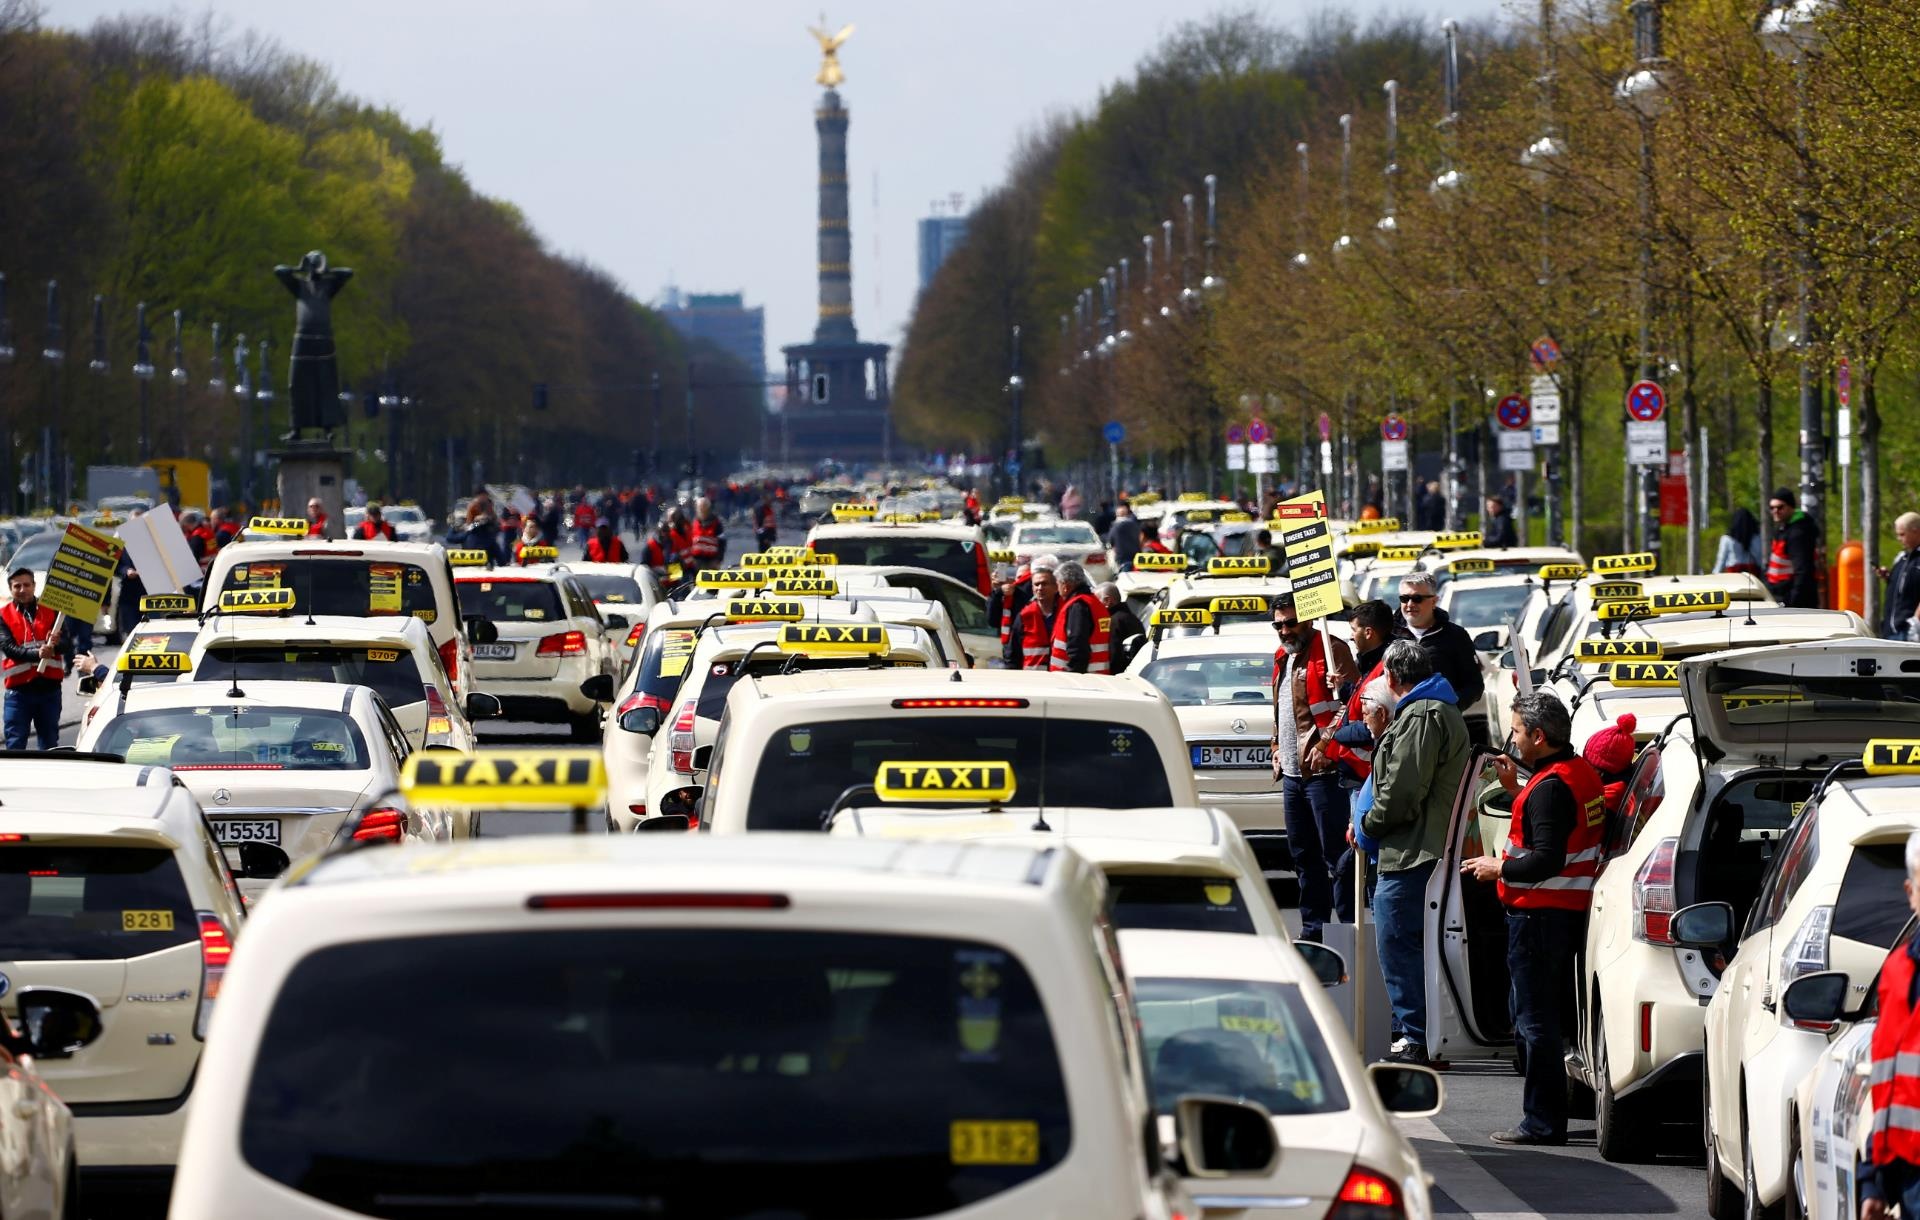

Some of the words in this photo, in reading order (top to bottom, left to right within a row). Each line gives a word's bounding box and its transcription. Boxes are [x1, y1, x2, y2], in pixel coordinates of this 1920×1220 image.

[260, 518, 298, 528] TAXI
[1285, 532, 1304, 542] UNSERE
[1303, 528, 1317, 537] TAXIS
[748, 556, 787, 565] TAXI
[1144, 556, 1178, 564] TAXI
[1219, 559, 1260, 568] TAXI
[1290, 556, 1308, 566] UNSERE
[1308, 552, 1321, 561] JOBS
[1604, 555, 1645, 567] TAXI
[1458, 562, 1487, 570] TAXI
[709, 571, 755, 581] TAXI
[775, 569, 815, 578] TAXI
[1551, 567, 1580, 577] TAXI
[784, 580, 826, 590] TAXI
[1293, 580, 1308, 589] DEINE
[1601, 587, 1634, 596] TAXI
[232, 591, 280, 605] TAXI
[1662, 592, 1715, 606] TAXI
[151, 600, 184, 609] TAXI
[739, 603, 790, 614] TAXI
[1221, 600, 1257, 611] TAXI
[1610, 604, 1650, 616] TAXI
[1162, 611, 1201, 622] TAXI
[797, 627, 868, 642] TAXI
[1590, 642, 1648, 655] TAXI
[131, 655, 178, 668] TAXI
[370, 651, 397, 661] 3705
[1627, 664, 1679, 680] TAX
[1202, 749, 1212, 763] B
[1223, 749, 1243, 763] QT
[1886, 745, 1920, 764] TA
[434, 756, 569, 785] TAXI
[899, 767, 990, 789] TAXI
[230, 823, 277, 841] 5531
[124, 913, 173, 929] 8281
